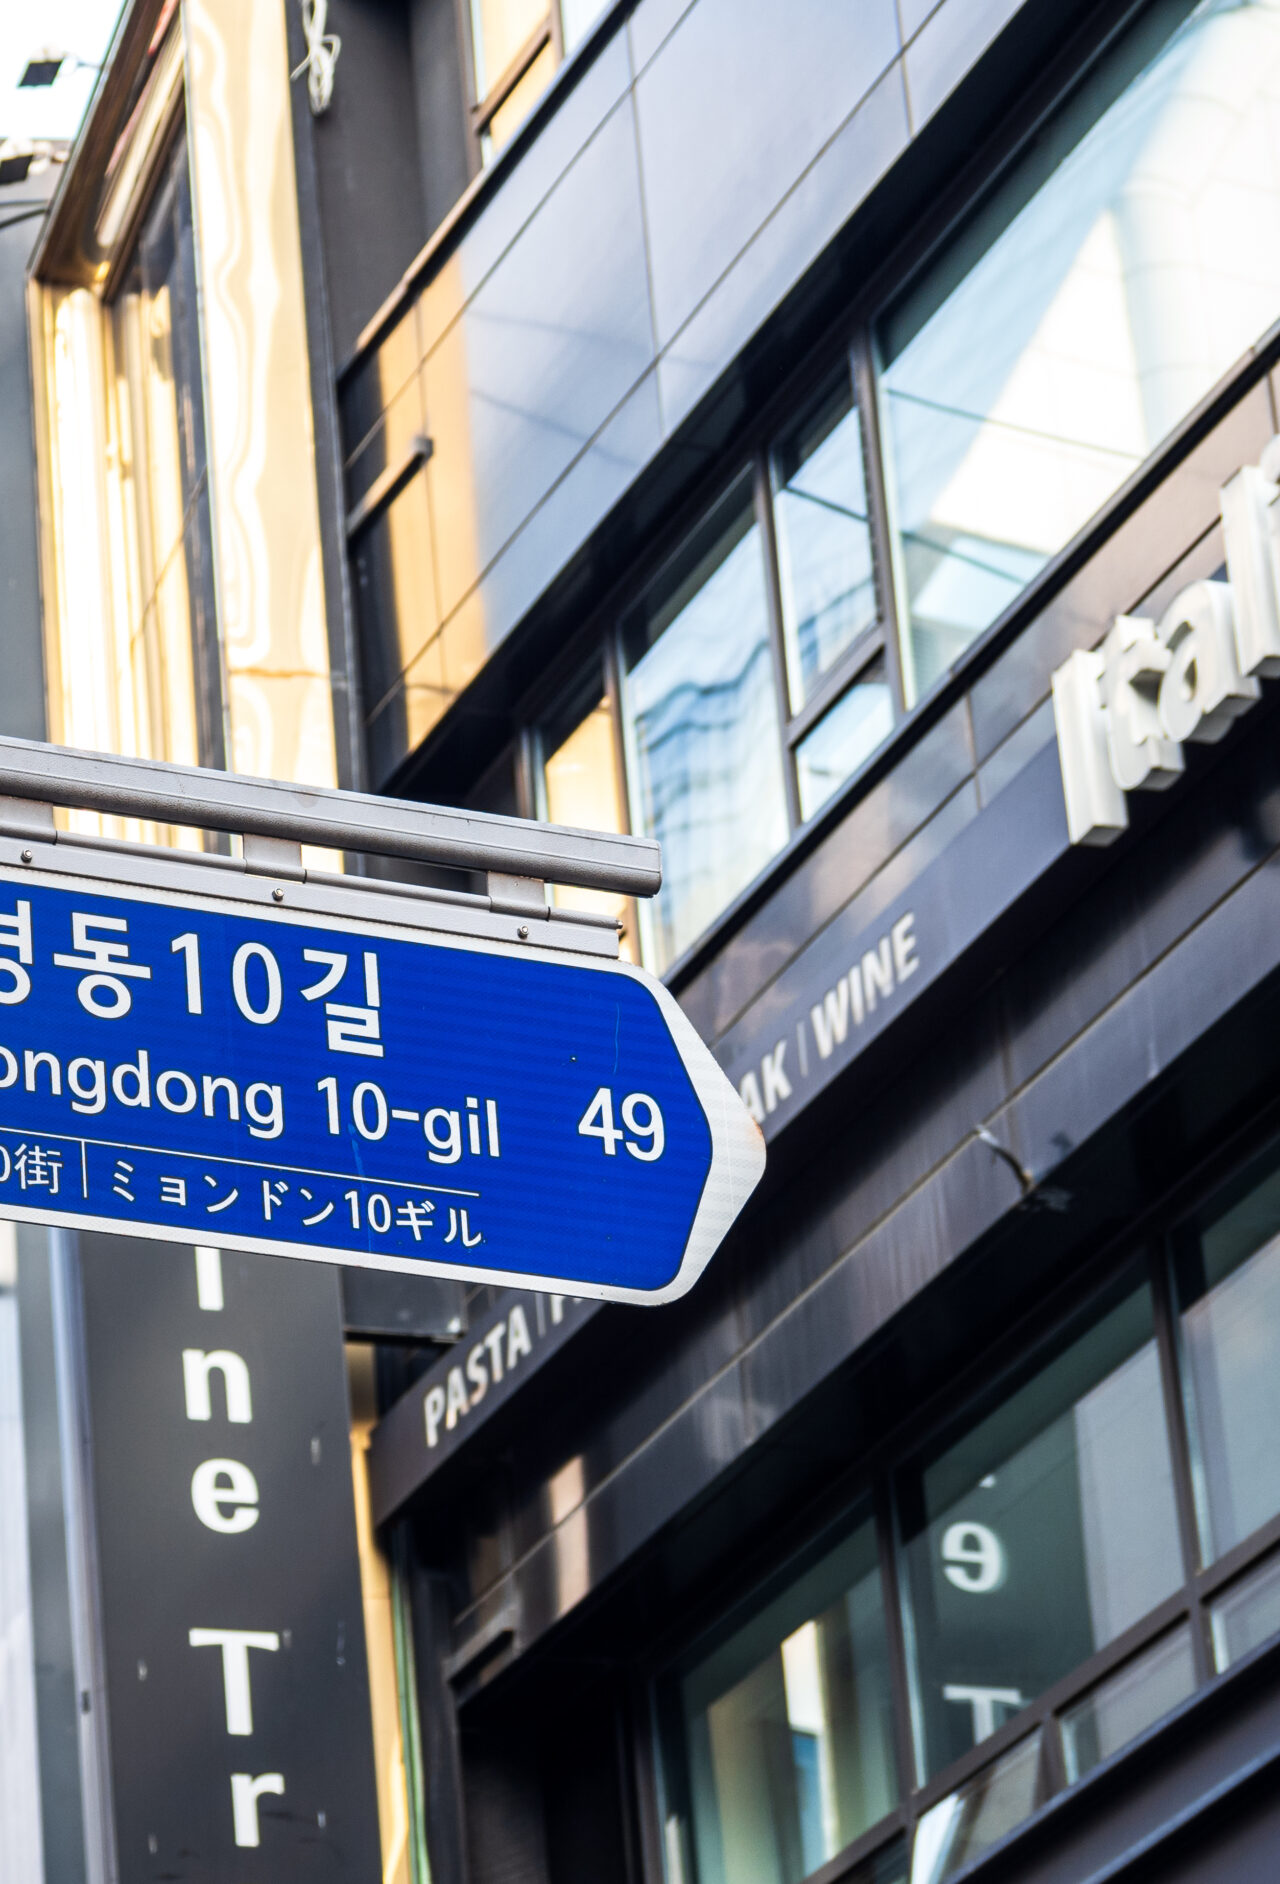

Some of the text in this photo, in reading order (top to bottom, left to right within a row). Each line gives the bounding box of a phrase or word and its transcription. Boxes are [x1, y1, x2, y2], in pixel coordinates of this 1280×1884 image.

[810, 911, 919, 1060] WINE
[317, 1077, 500, 1164] 10-gil
[578, 1087, 665, 1162] 49
[424, 1304, 532, 1448] PASTA
